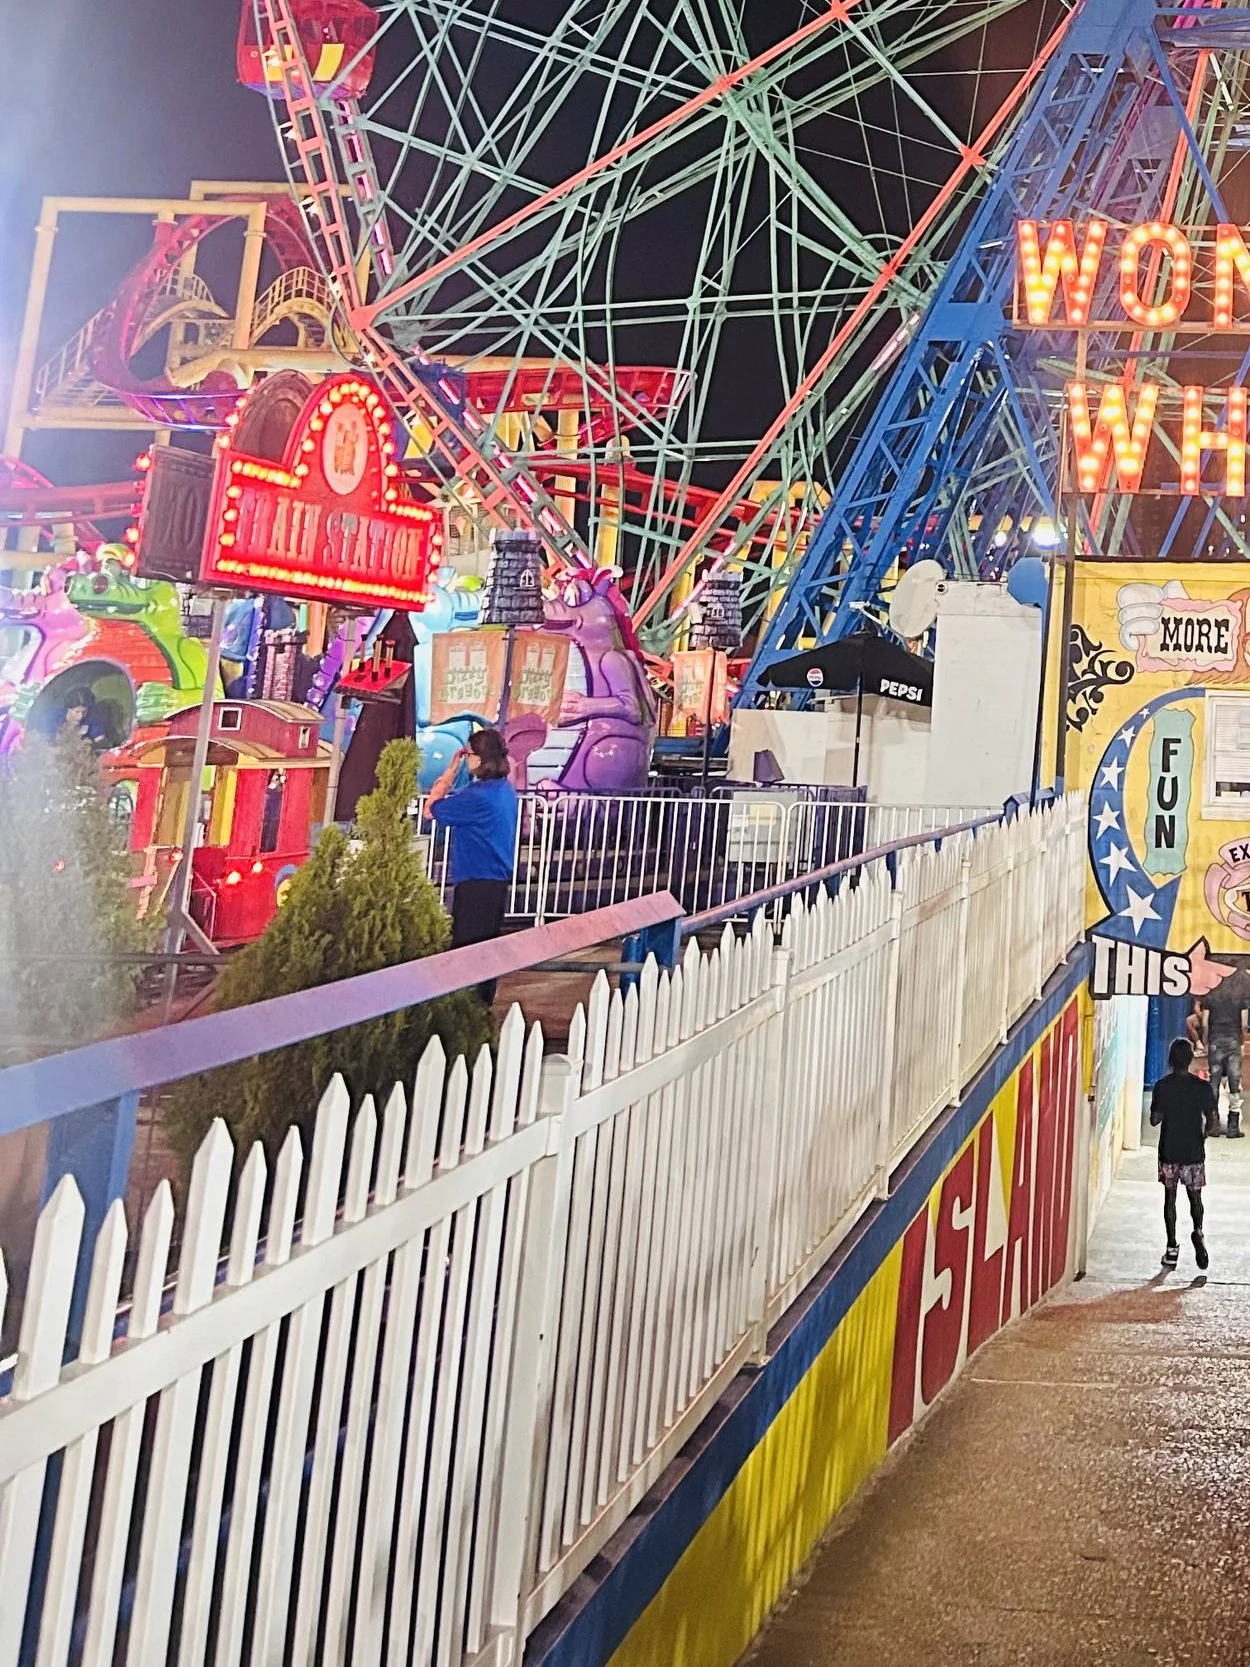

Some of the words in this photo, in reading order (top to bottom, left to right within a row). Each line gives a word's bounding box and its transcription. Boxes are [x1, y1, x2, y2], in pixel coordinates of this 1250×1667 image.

[234, 486, 322, 562] TRAIN
[323, 508, 424, 582] STATION
[1159, 617, 1230, 656] MORE
[880, 678, 923, 702] PEPSI
[1154, 737, 1182, 850] FUN
[1091, 934, 1191, 996] THIS
